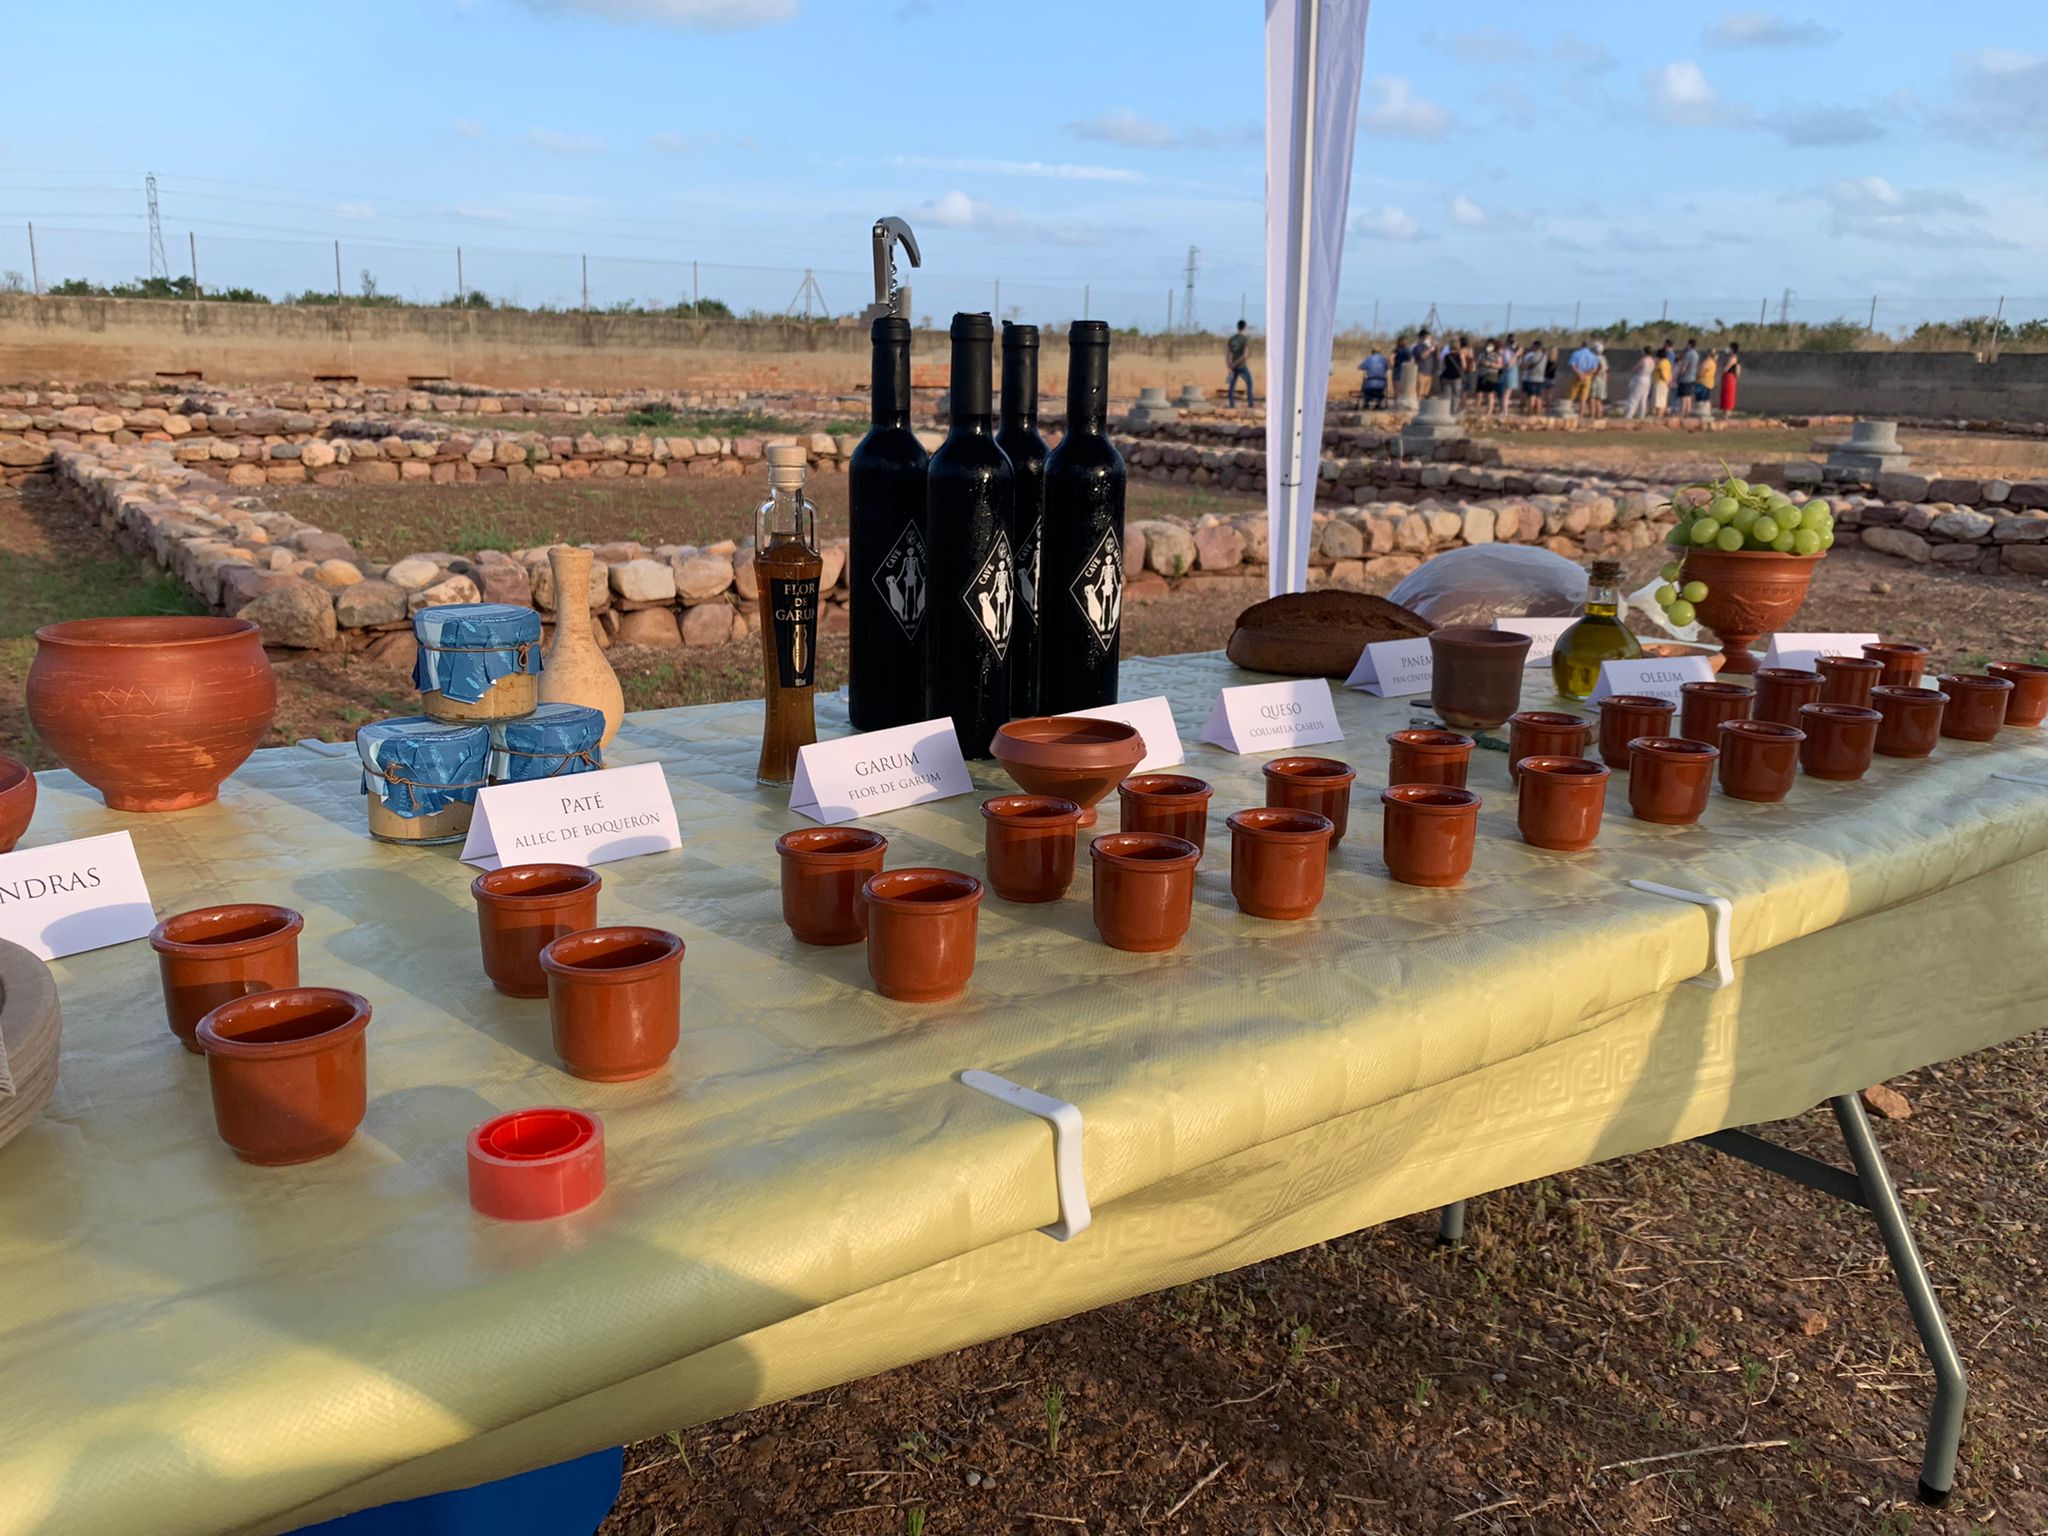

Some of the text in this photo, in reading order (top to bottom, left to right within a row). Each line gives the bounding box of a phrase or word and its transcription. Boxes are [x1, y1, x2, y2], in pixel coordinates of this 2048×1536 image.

[885, 548, 902, 569] CAVE
[1084, 557, 1101, 578] CAVE
[978, 562, 995, 585] CAVE
[783, 583, 815, 595] FLOR
[794, 597, 808, 607] DE
[1392, 676, 1406, 684] PAN
[1640, 671, 1684, 683] OLEUM
[1260, 702, 1302, 720] QUESO
[1249, 720, 1325, 738] COLUMELA CASEUS
[855, 752, 920, 777] GARUM
[848, 772, 941, 801] FLOR DE GARUM
[561, 792, 604, 814] PATÉ
[515, 812, 661, 849] ALLEC DE BOQUERÓN
